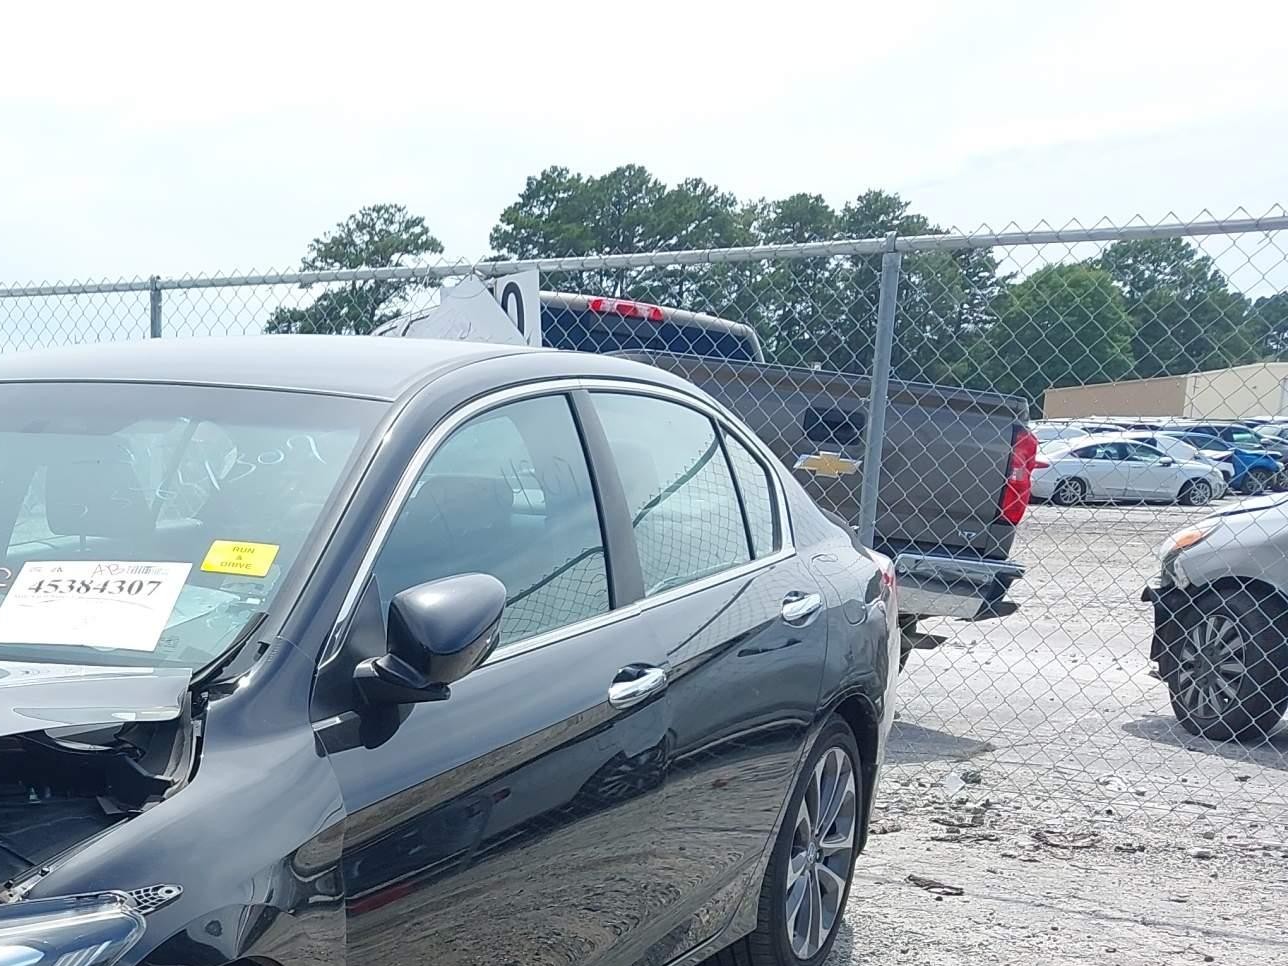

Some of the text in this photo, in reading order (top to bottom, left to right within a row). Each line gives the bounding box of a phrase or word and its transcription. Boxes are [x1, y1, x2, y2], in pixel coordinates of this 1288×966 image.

[232, 546, 255, 554] RUN
[220, 561, 253, 570] DRIVE
[28, 579, 163, 597] 45384307
